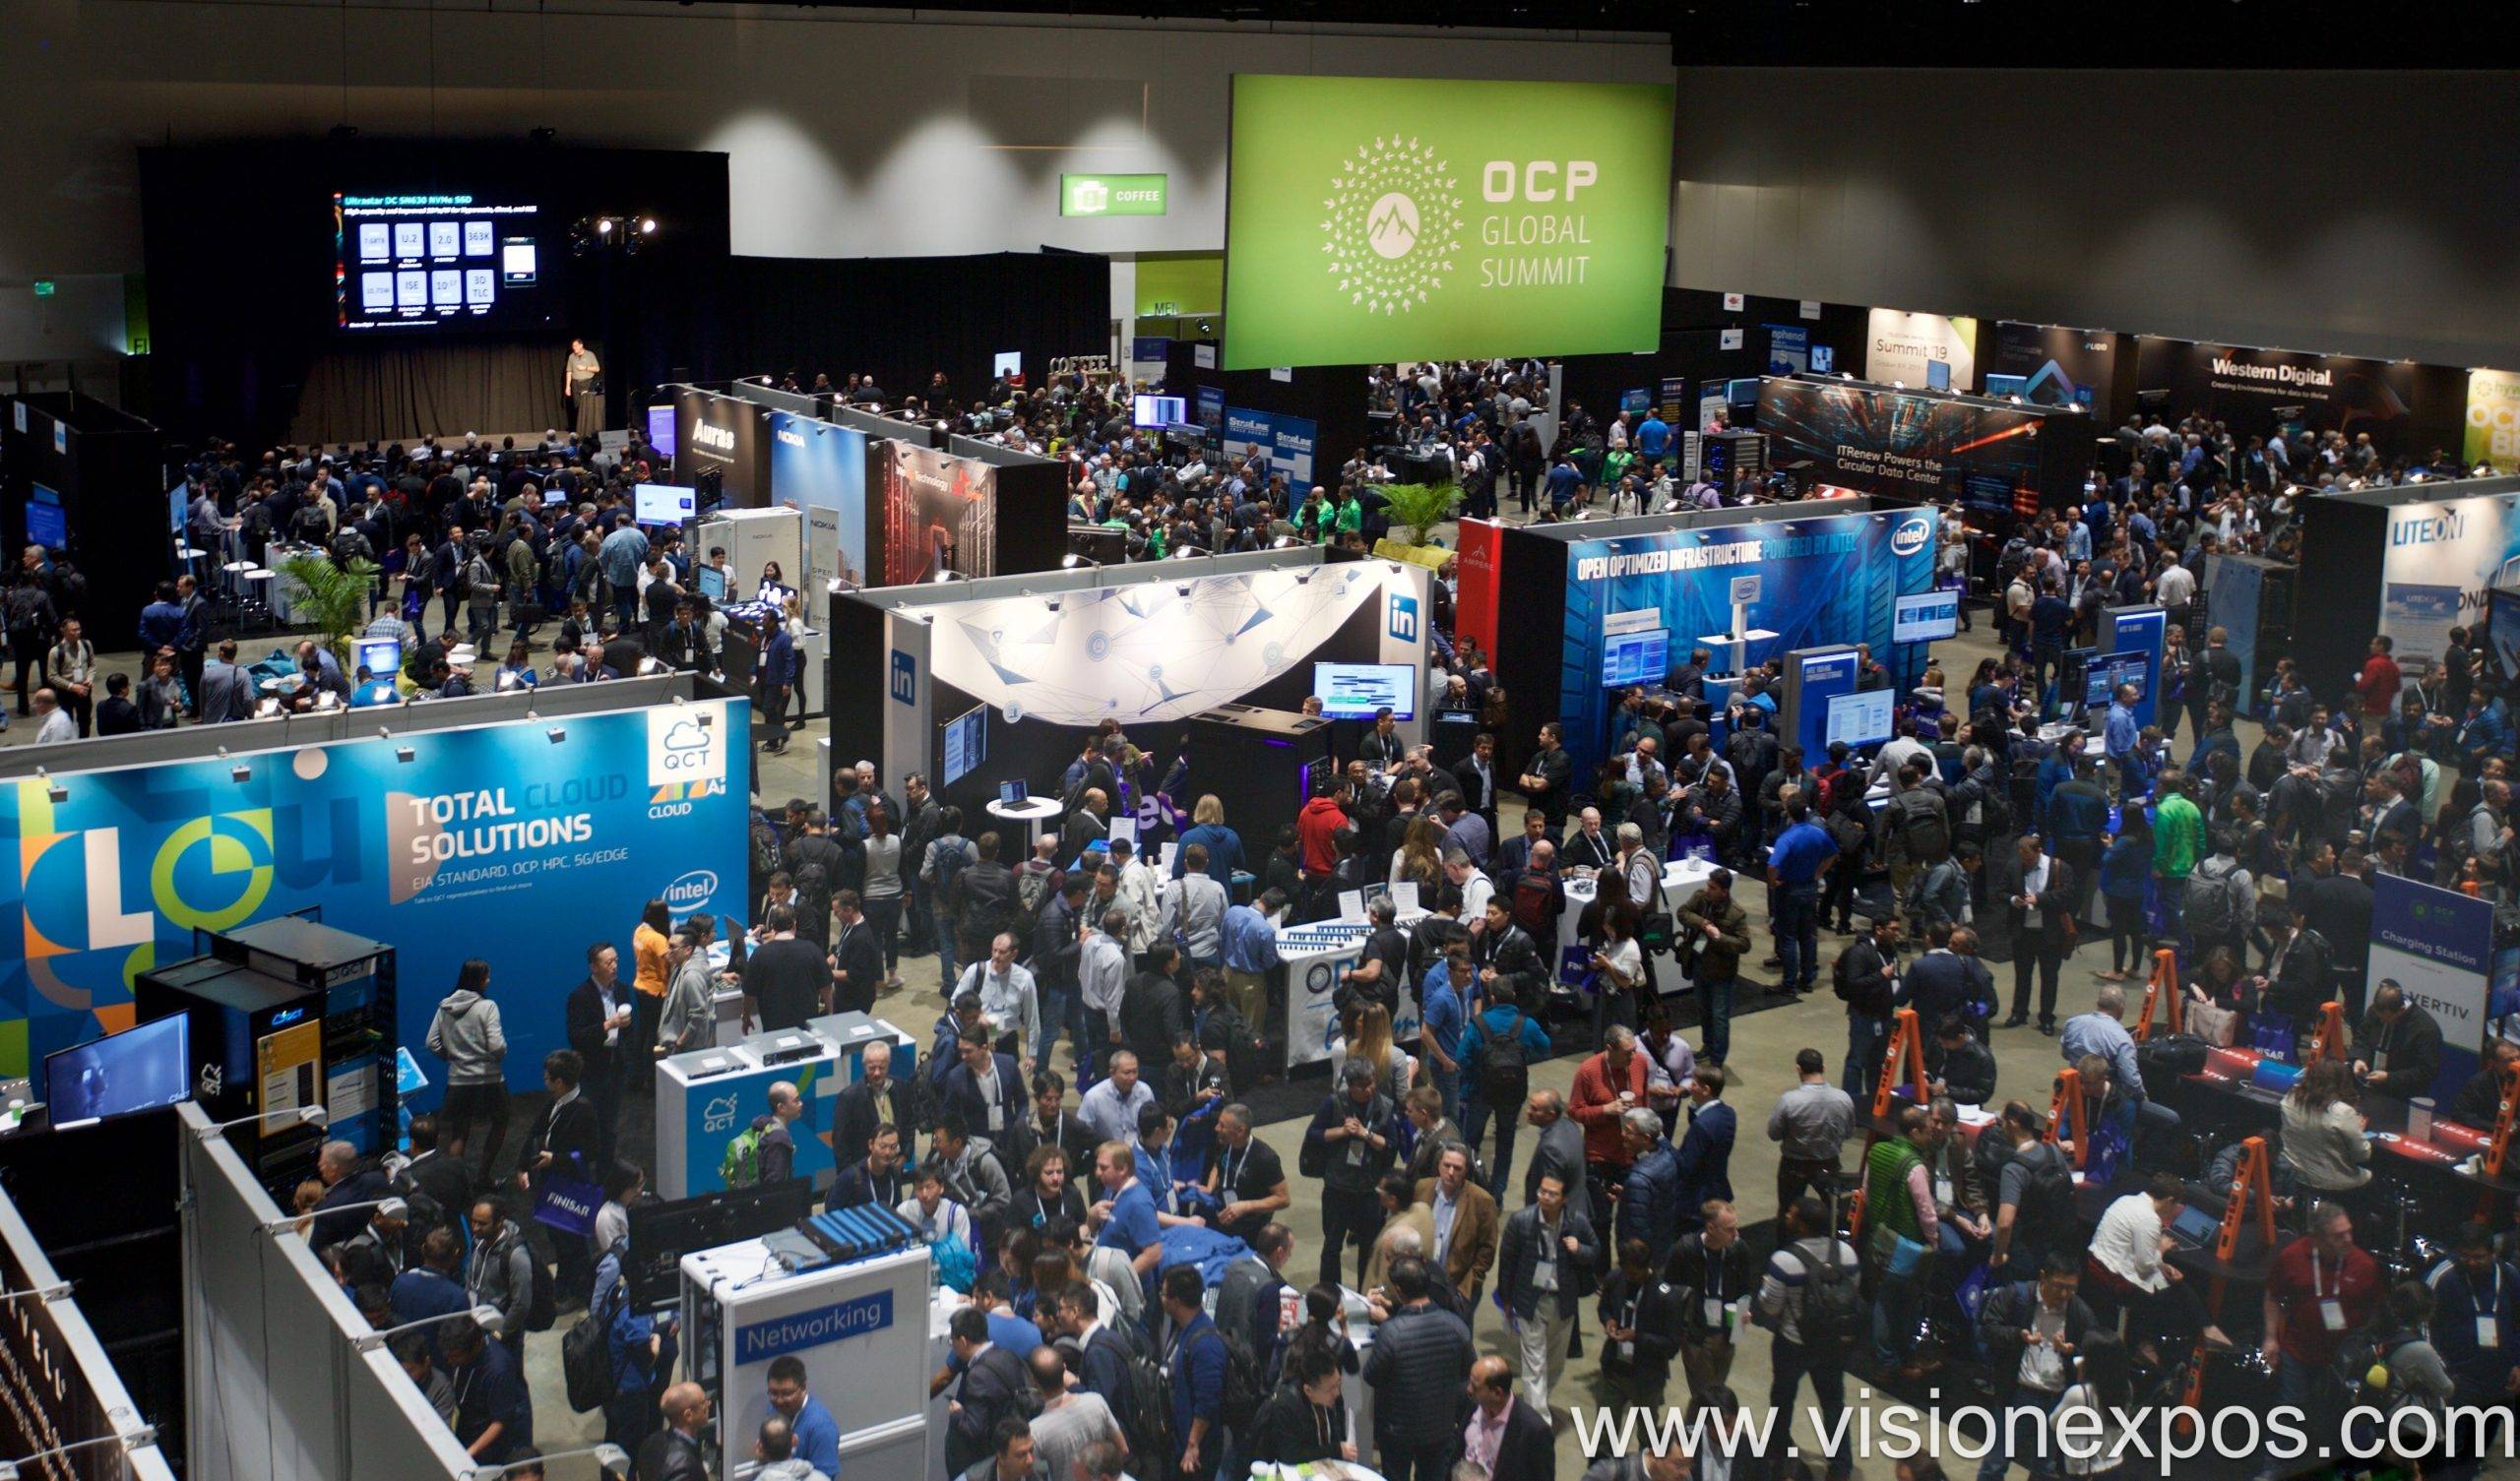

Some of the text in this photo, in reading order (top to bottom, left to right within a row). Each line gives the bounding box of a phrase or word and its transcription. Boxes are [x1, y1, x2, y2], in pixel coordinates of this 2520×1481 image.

[1481, 160, 1598, 203] OCP
[385, 196, 398, 205] DC
[1115, 190, 1161, 202] COFFEE
[1481, 215, 1592, 246] GLOBAL
[1480, 256, 1591, 287] SUMMIT
[1876, 339, 1928, 358] Summit
[2212, 357, 2278, 381] Western
[692, 417, 734, 451] Auras
[777, 429, 805, 449] NOKIA
[1837, 445, 1942, 472] ITRenew Powers the
[1837, 458, 1941, 485] Circular Data Center
[913, 470, 949, 493] Technology
[809, 519, 837, 531] NOKIA
[1896, 526, 1926, 545] intel
[1463, 556, 1494, 570] AMPERE
[1577, 531, 1858, 581] OPEN OPTIMIZED INFRASTRUCTURE POWERED BY INTEL
[812, 567, 833, 576] OPEN
[1392, 598, 1415, 637] in
[894, 656, 913, 700] in
[664, 750, 710, 770] QCT
[410, 773, 628, 827] TOTAL CLOUD
[648, 802, 692, 819] CLOUD
[411, 813, 593, 865] SOLUTIONS
[412, 874, 434, 891] EIA
[574, 847, 628, 867] 5G/EDGE
[433, 894, 445, 902] QCT
[446, 889, 488, 899] representatives
[669, 878, 710, 901] intel
[2381, 929, 2477, 965] Charging Station
[2409, 990, 2469, 1020] VERTIV
[704, 1116, 735, 1133] QCT
[547, 1192, 591, 1218] FINISAR
[747, 1302, 881, 1353] Networking
